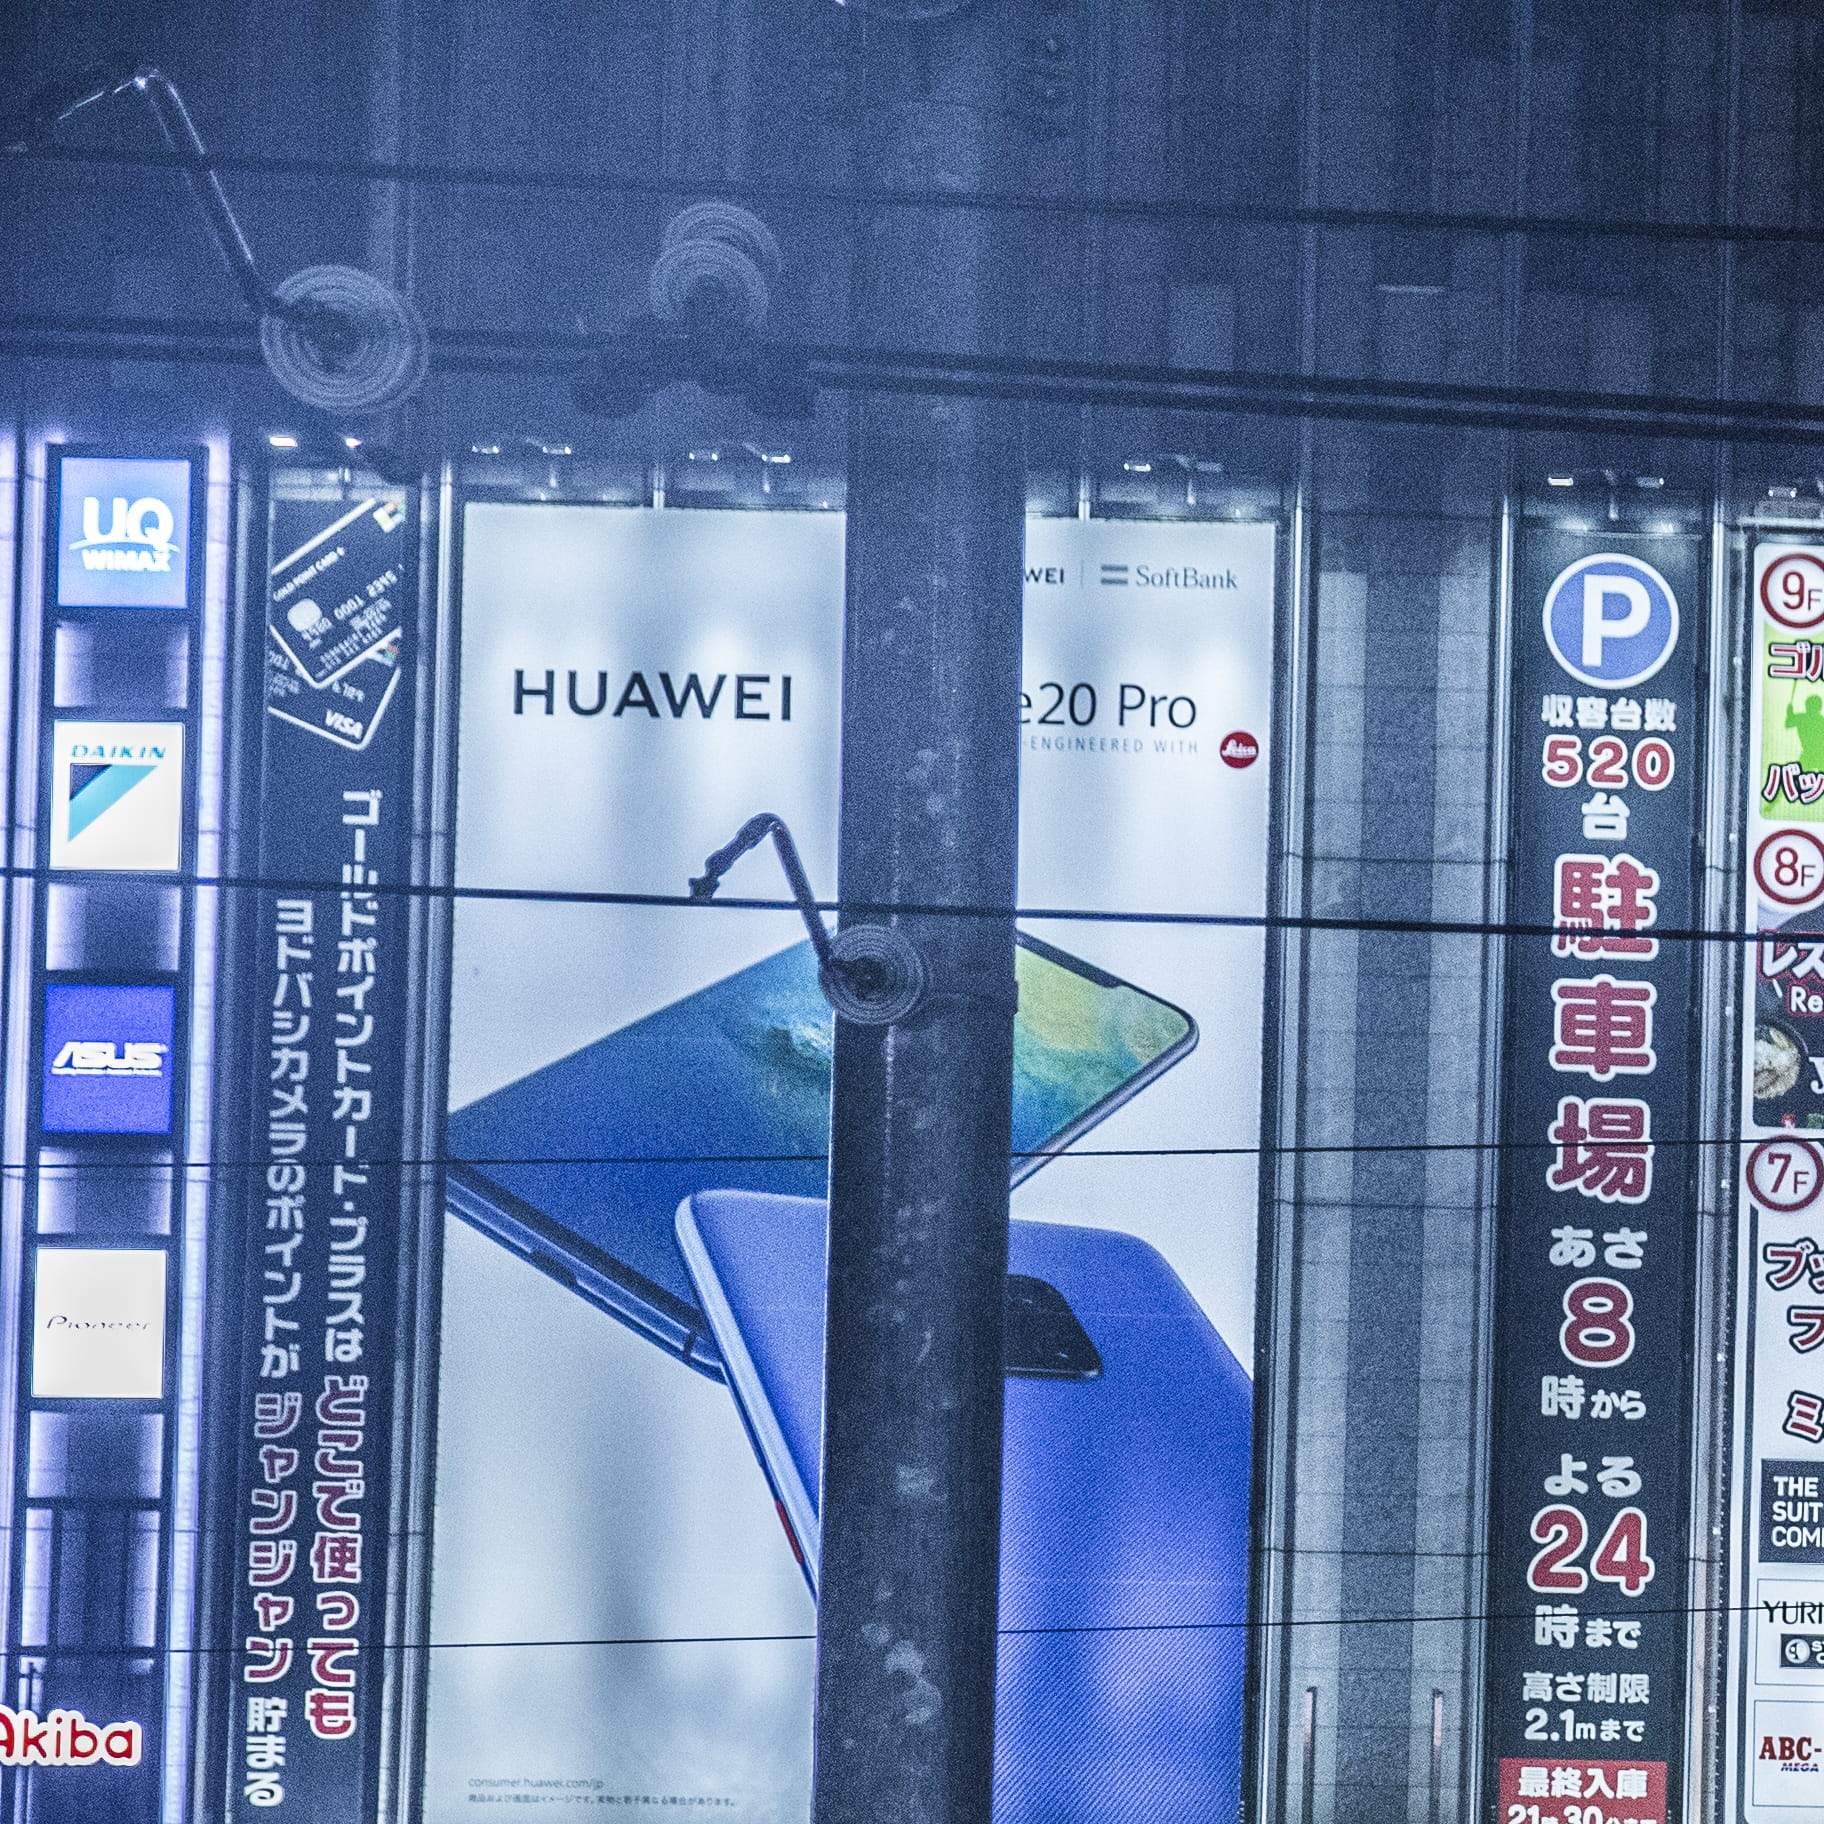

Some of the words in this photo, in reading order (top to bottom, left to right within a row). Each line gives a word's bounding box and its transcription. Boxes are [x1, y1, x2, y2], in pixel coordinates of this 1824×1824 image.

[83, 497, 175, 553] UQ
[1135, 564, 1238, 589] SoftBank
[1781, 571, 1823, 611] 9F
[1582, 573, 1651, 668] P
[513, 668, 794, 723] HUAWEI
[1118, 683, 1196, 728] Pro
[1542, 694, 1677, 732] 収容台数
[324, 709, 364, 739] VISA
[71, 744, 166, 760] DAIKIN
[1154, 739, 1198, 753] WITH
[1542, 735, 1676, 790] 520
[1581, 793, 1630, 840] 台
[1774, 847, 1816, 887] 8F
[1548, 853, 1661, 1203] 駐車場
[52, 1042, 168, 1077] ASUS
[1548, 1224, 1648, 1270] あさ
[1559, 1277, 1635, 1367] 8
[1540, 1374, 1647, 1420] 時から
[1543, 1455, 1643, 1498] よる
[1773, 1476, 1819, 1497] THE
[1772, 1501, 1823, 1523] SUIT
[1526, 1503, 1654, 1595] 24
[1534, 1605, 1641, 1651] 時まで
[1522, 1670, 1650, 1705] 高さ制限
[1523, 1708, 1645, 1743] 2.1mまで
[1518, 1766, 1648, 1800] 最終入庫
[1781, 1763, 1819, 1773] MEGA
